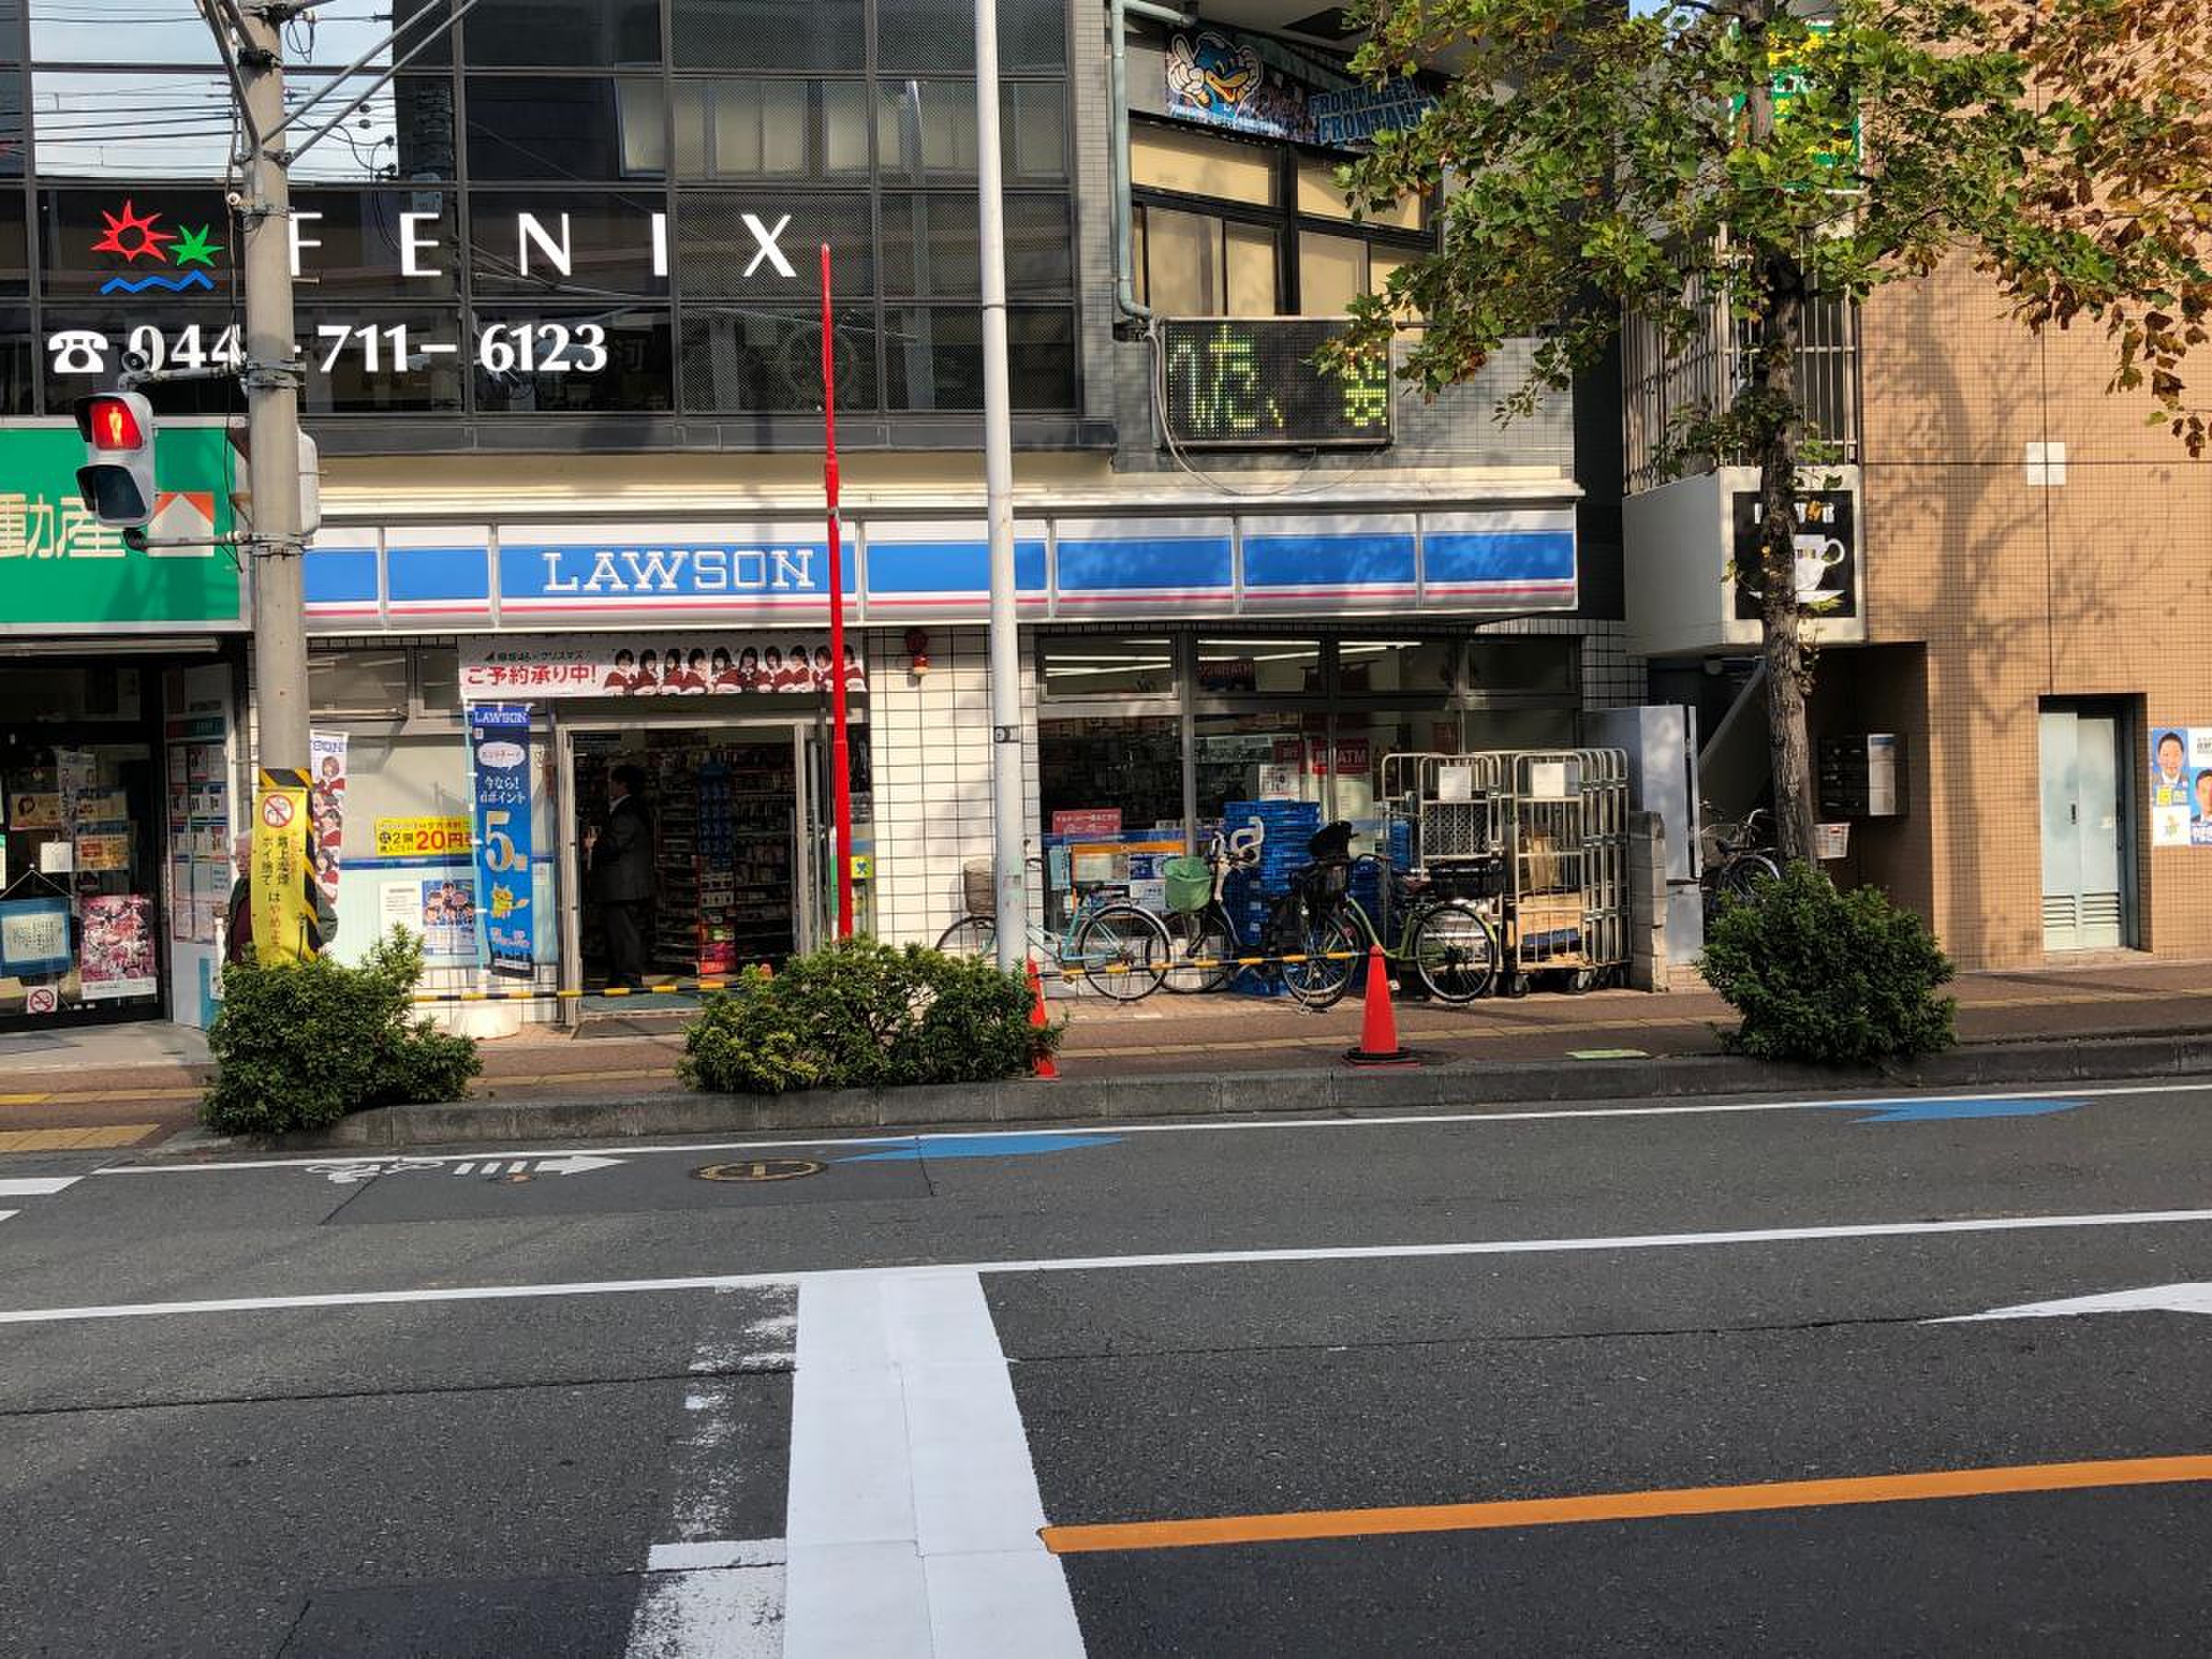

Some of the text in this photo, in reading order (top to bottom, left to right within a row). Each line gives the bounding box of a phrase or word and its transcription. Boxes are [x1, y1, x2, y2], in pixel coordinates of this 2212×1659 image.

[128, 323, 608, 374] 044711-6123
[542, 548, 816, 592] LAWSON
[467, 664, 596, 686] ご予約承り中!
[474, 711, 528, 724] LAWSON
